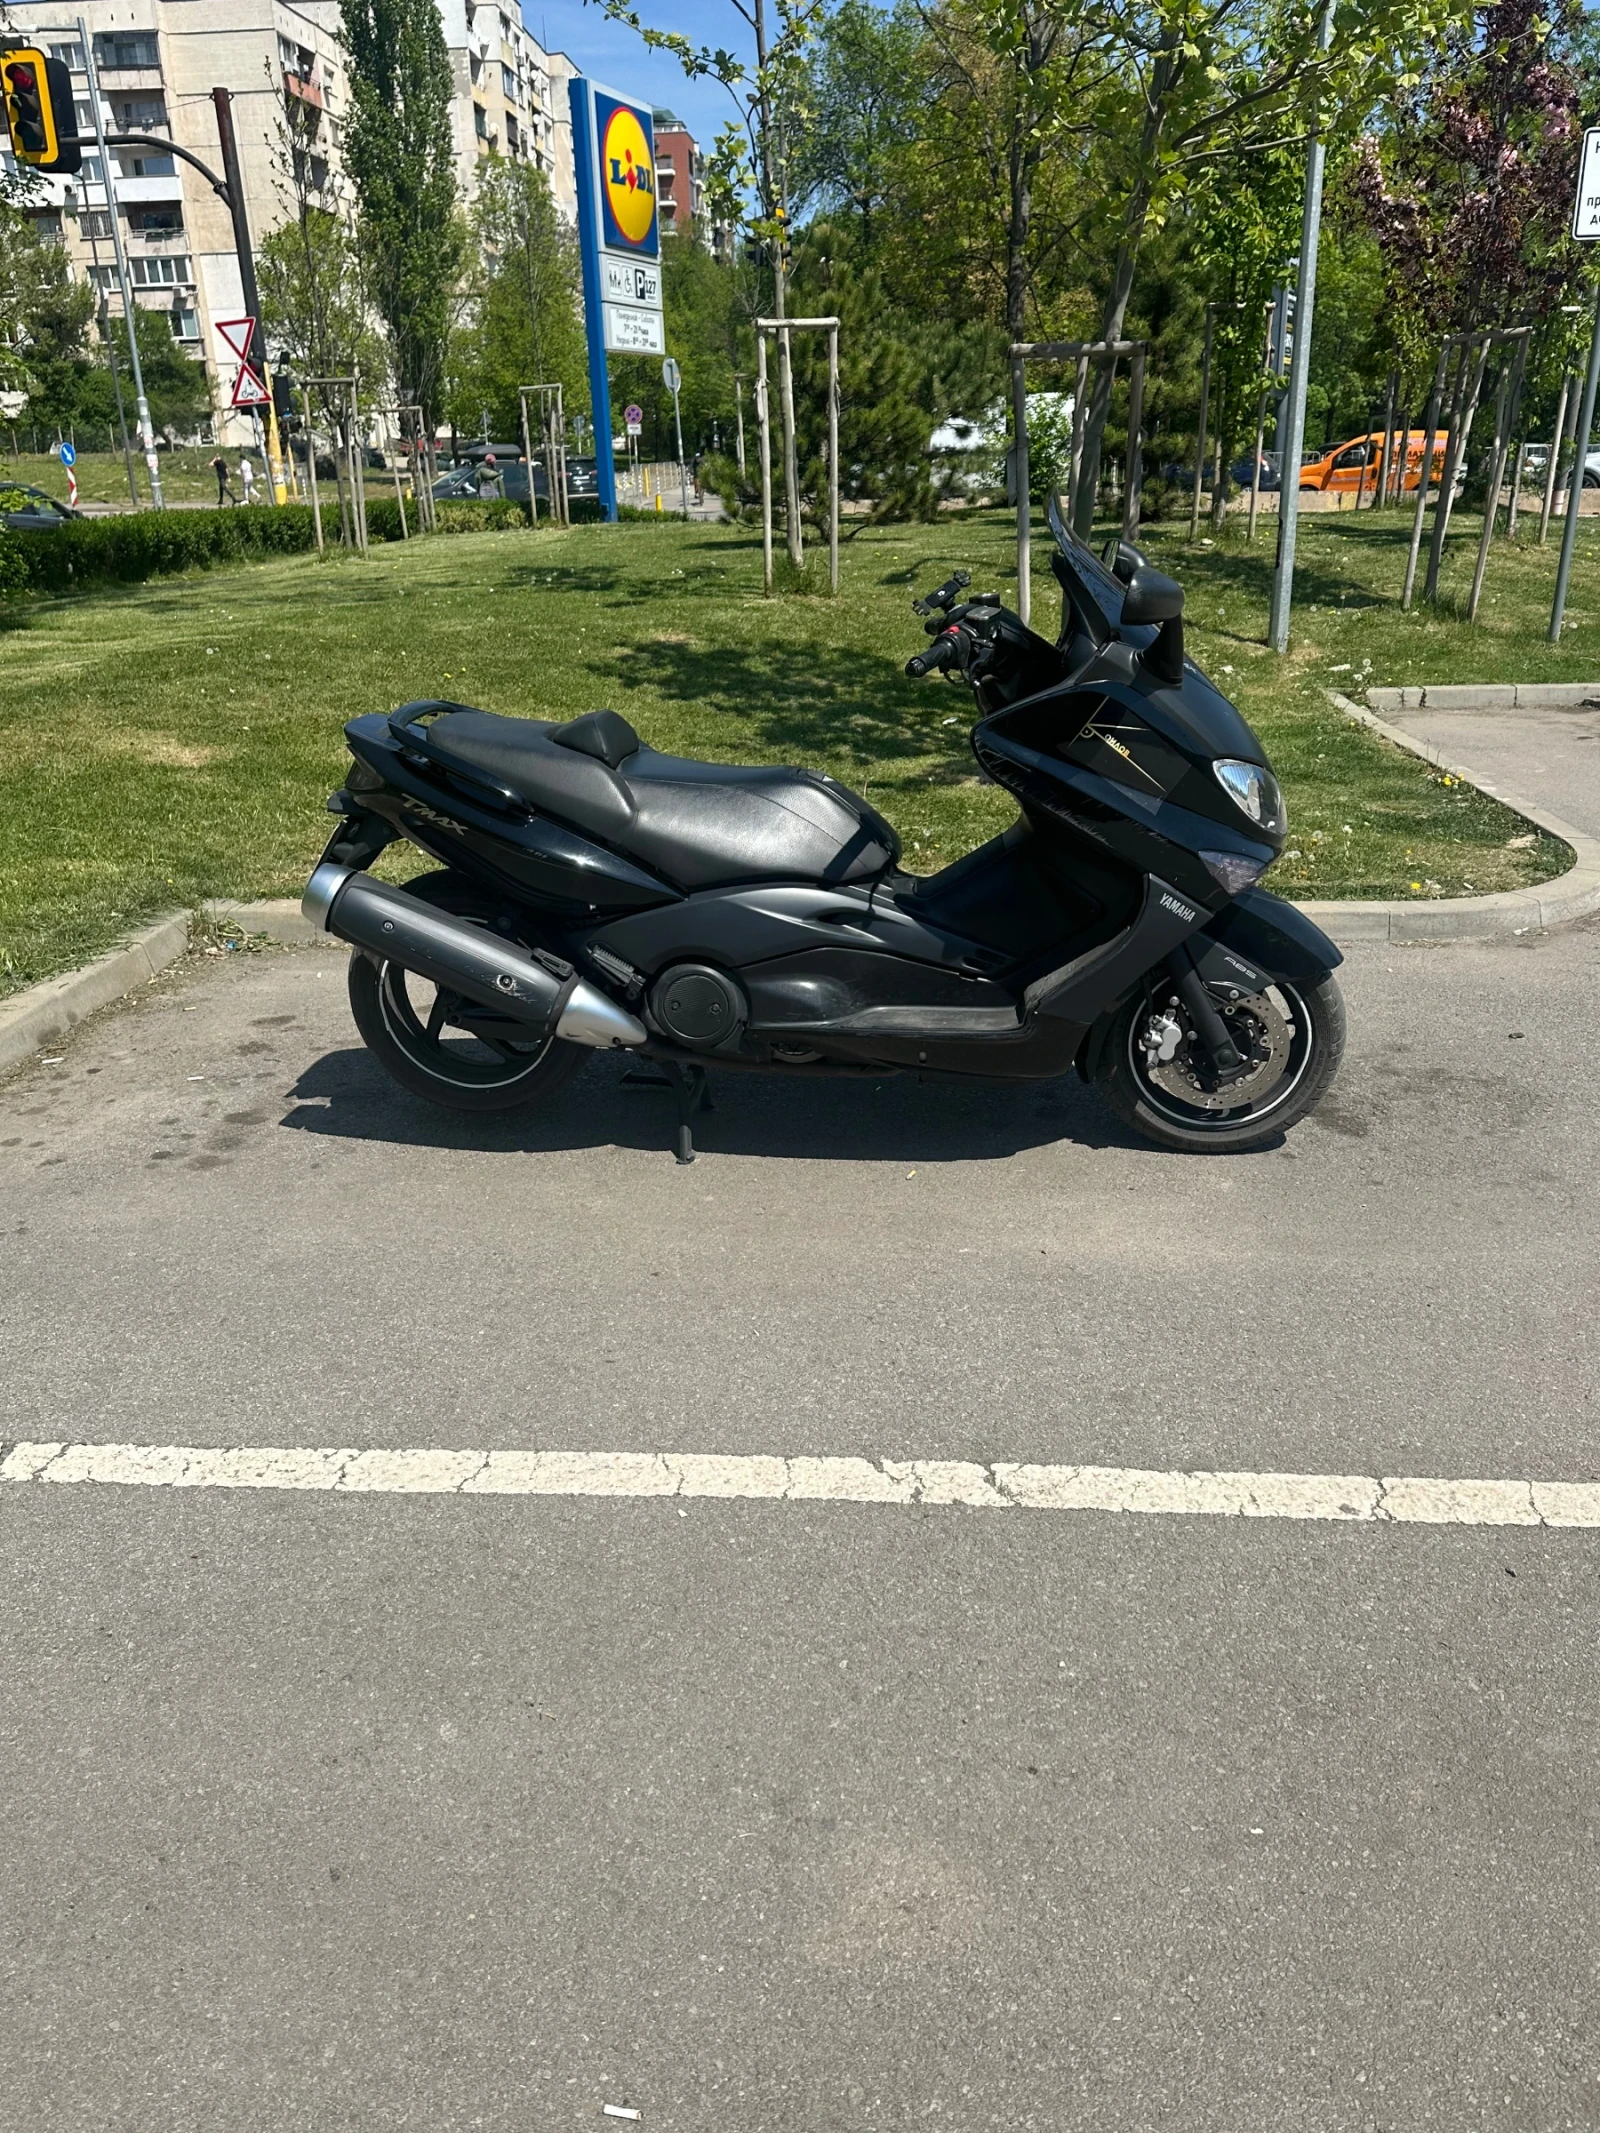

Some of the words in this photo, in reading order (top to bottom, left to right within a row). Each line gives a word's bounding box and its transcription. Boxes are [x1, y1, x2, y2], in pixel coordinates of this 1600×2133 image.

[636, 271, 644, 297] P
[645, 279, 656, 295] 127
[1159, 892, 1197, 923] YAMAHA
[1223, 956, 1258, 980] ABS
